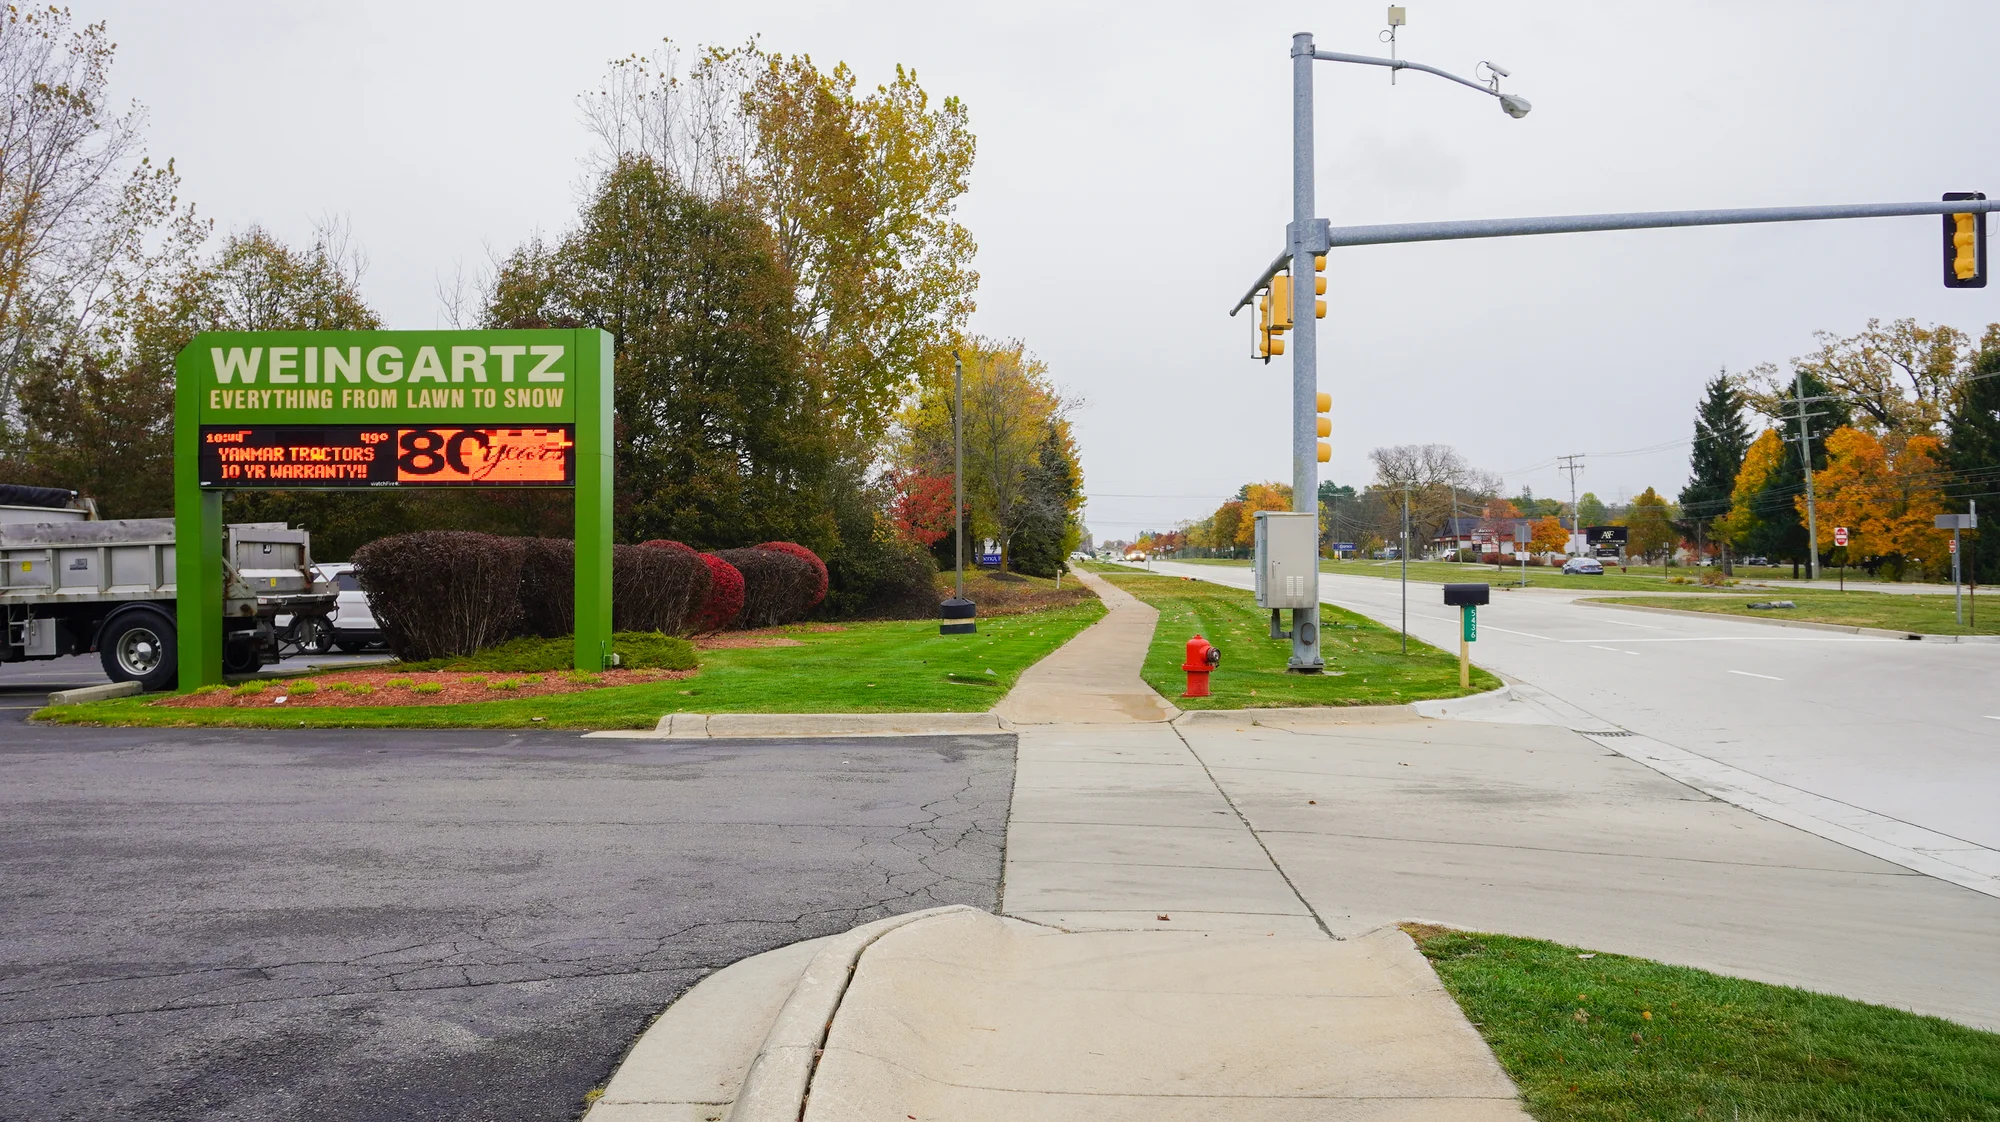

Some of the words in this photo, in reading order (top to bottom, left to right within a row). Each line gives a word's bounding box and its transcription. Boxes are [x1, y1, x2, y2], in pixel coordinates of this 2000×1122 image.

[210, 345, 565, 384] WEINGARTZ
[210, 388, 333, 409] EVERYTHING
[342, 388, 398, 409] FROM
[407, 388, 465, 409] LAWN
[471, 388, 497, 409] TO
[503, 387, 564, 409] SNOW
[218, 447, 285, 462] YANMAR
[288, 446, 375, 462] TRACTORS
[221, 464, 241, 479] 10
[244, 464, 267, 479] YR
[269, 464, 368, 479] WARRANTY!!
